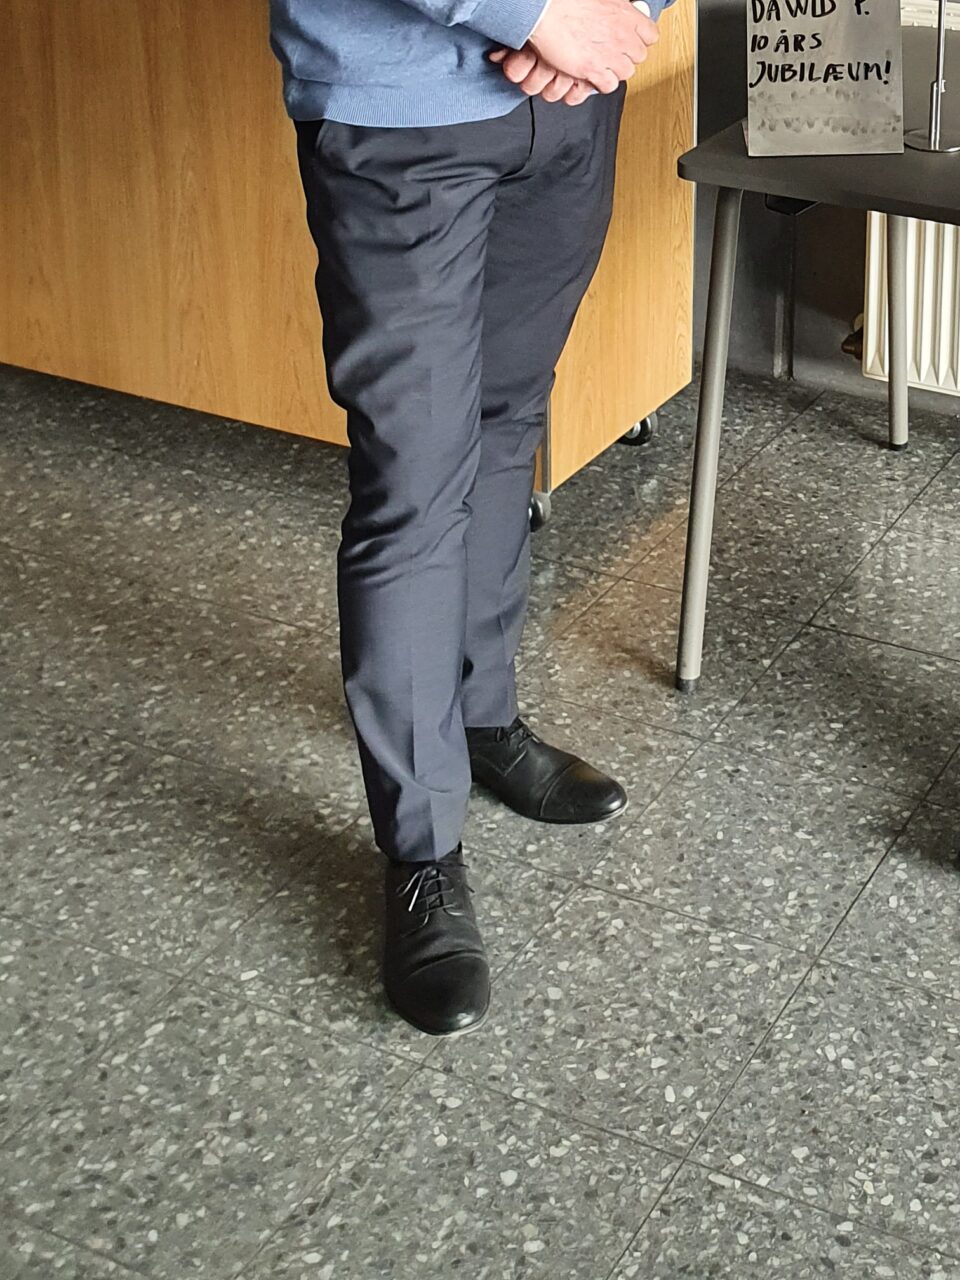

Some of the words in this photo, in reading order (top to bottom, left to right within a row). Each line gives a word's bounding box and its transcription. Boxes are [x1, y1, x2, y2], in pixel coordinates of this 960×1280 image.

[751, 34, 769, 53] 10
[774, 29, 822, 53] ÅRS
[749, 60, 892, 88] JUBILÆUM!
